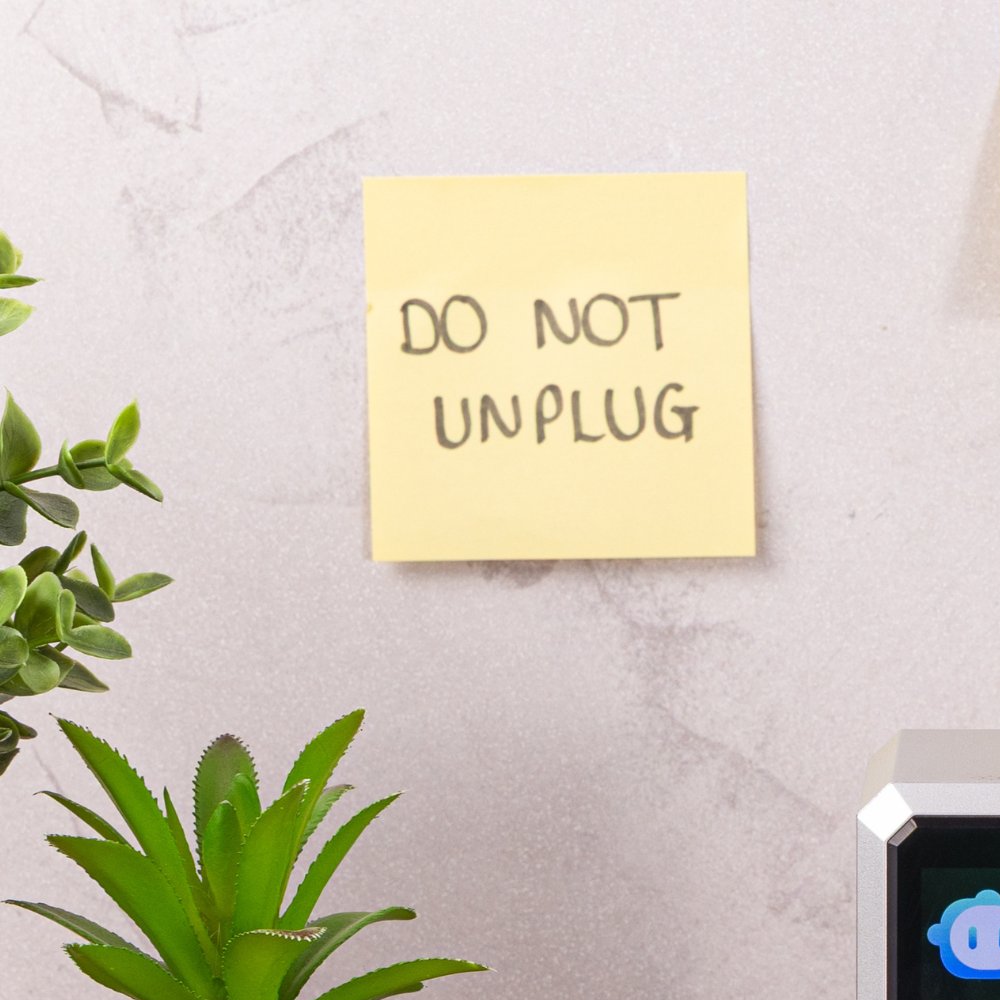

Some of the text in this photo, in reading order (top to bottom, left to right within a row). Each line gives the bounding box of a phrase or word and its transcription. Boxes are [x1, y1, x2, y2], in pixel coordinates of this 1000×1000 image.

[401, 292, 680, 355] DO NOT
[433, 382, 699, 450] UNPLUG
